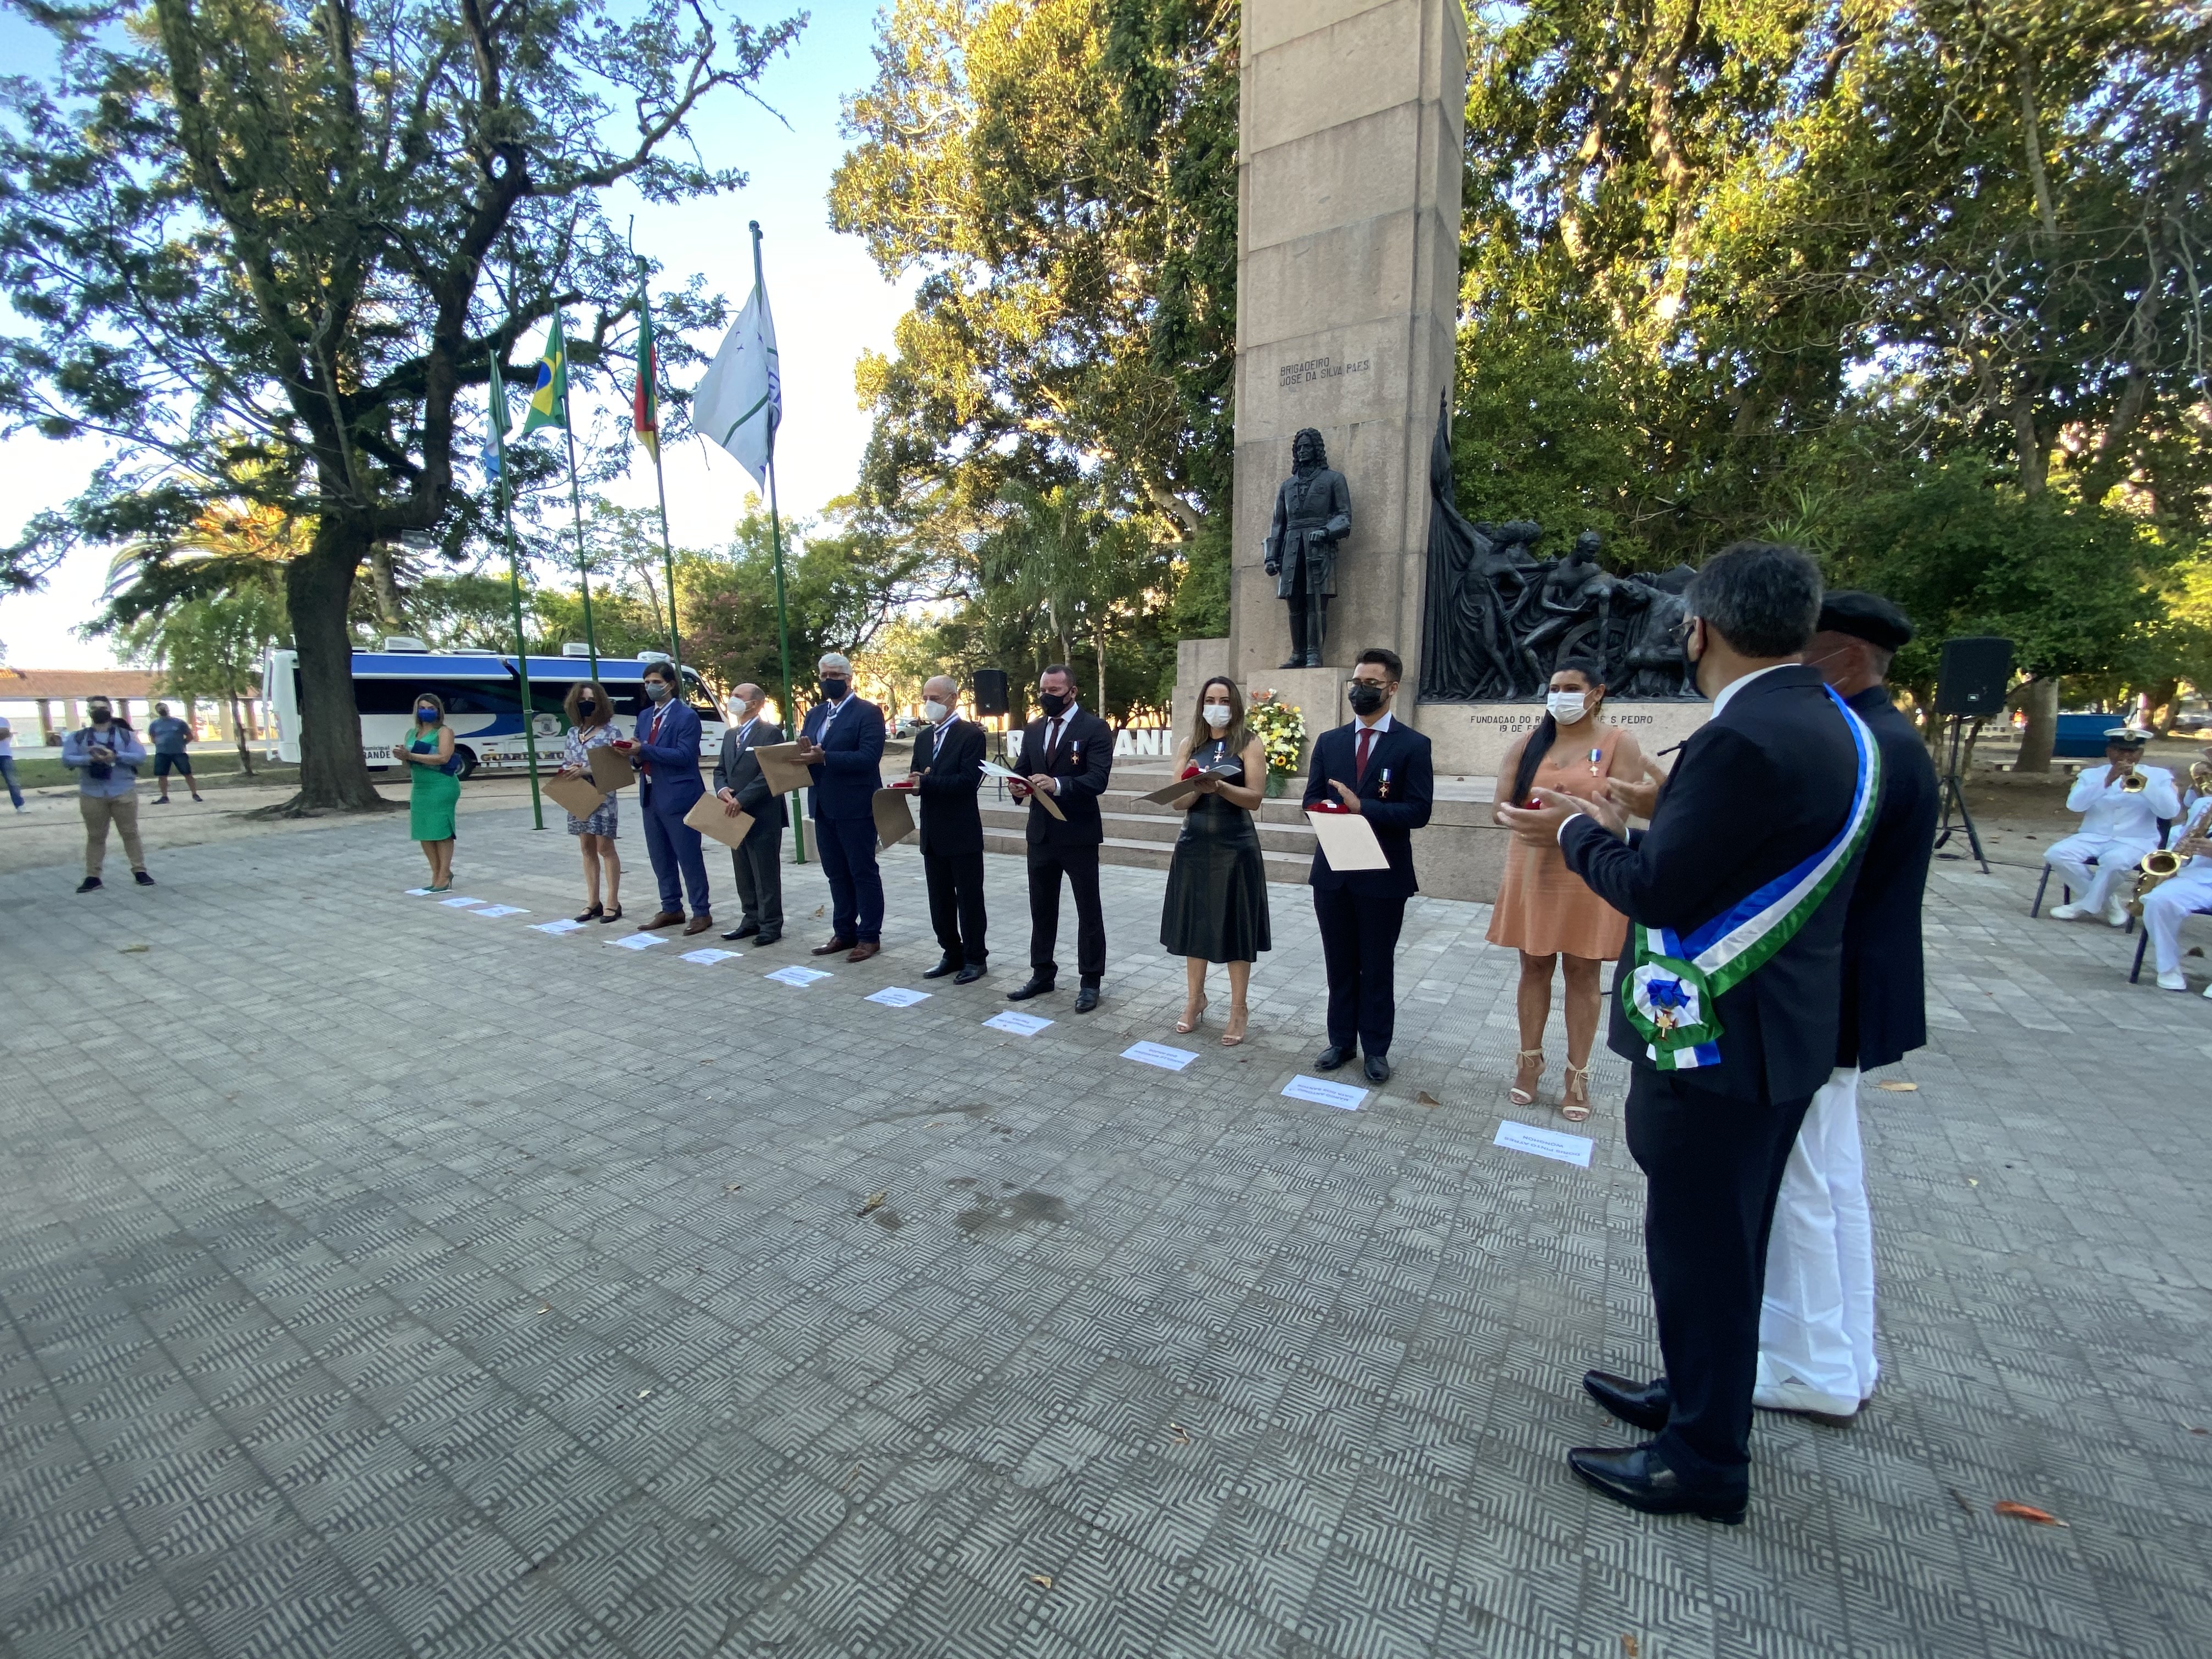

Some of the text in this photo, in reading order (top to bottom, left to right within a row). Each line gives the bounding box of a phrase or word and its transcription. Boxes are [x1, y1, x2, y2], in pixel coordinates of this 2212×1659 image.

[1280, 357, 1330, 376] BRIGADEIRO
[1280, 360, 1369, 387] JOSE DA SILVA PAES
[1519, 715, 1531, 724] DO
[1621, 715, 1653, 724] PEDRO
[363, 751, 391, 759] RANDE
